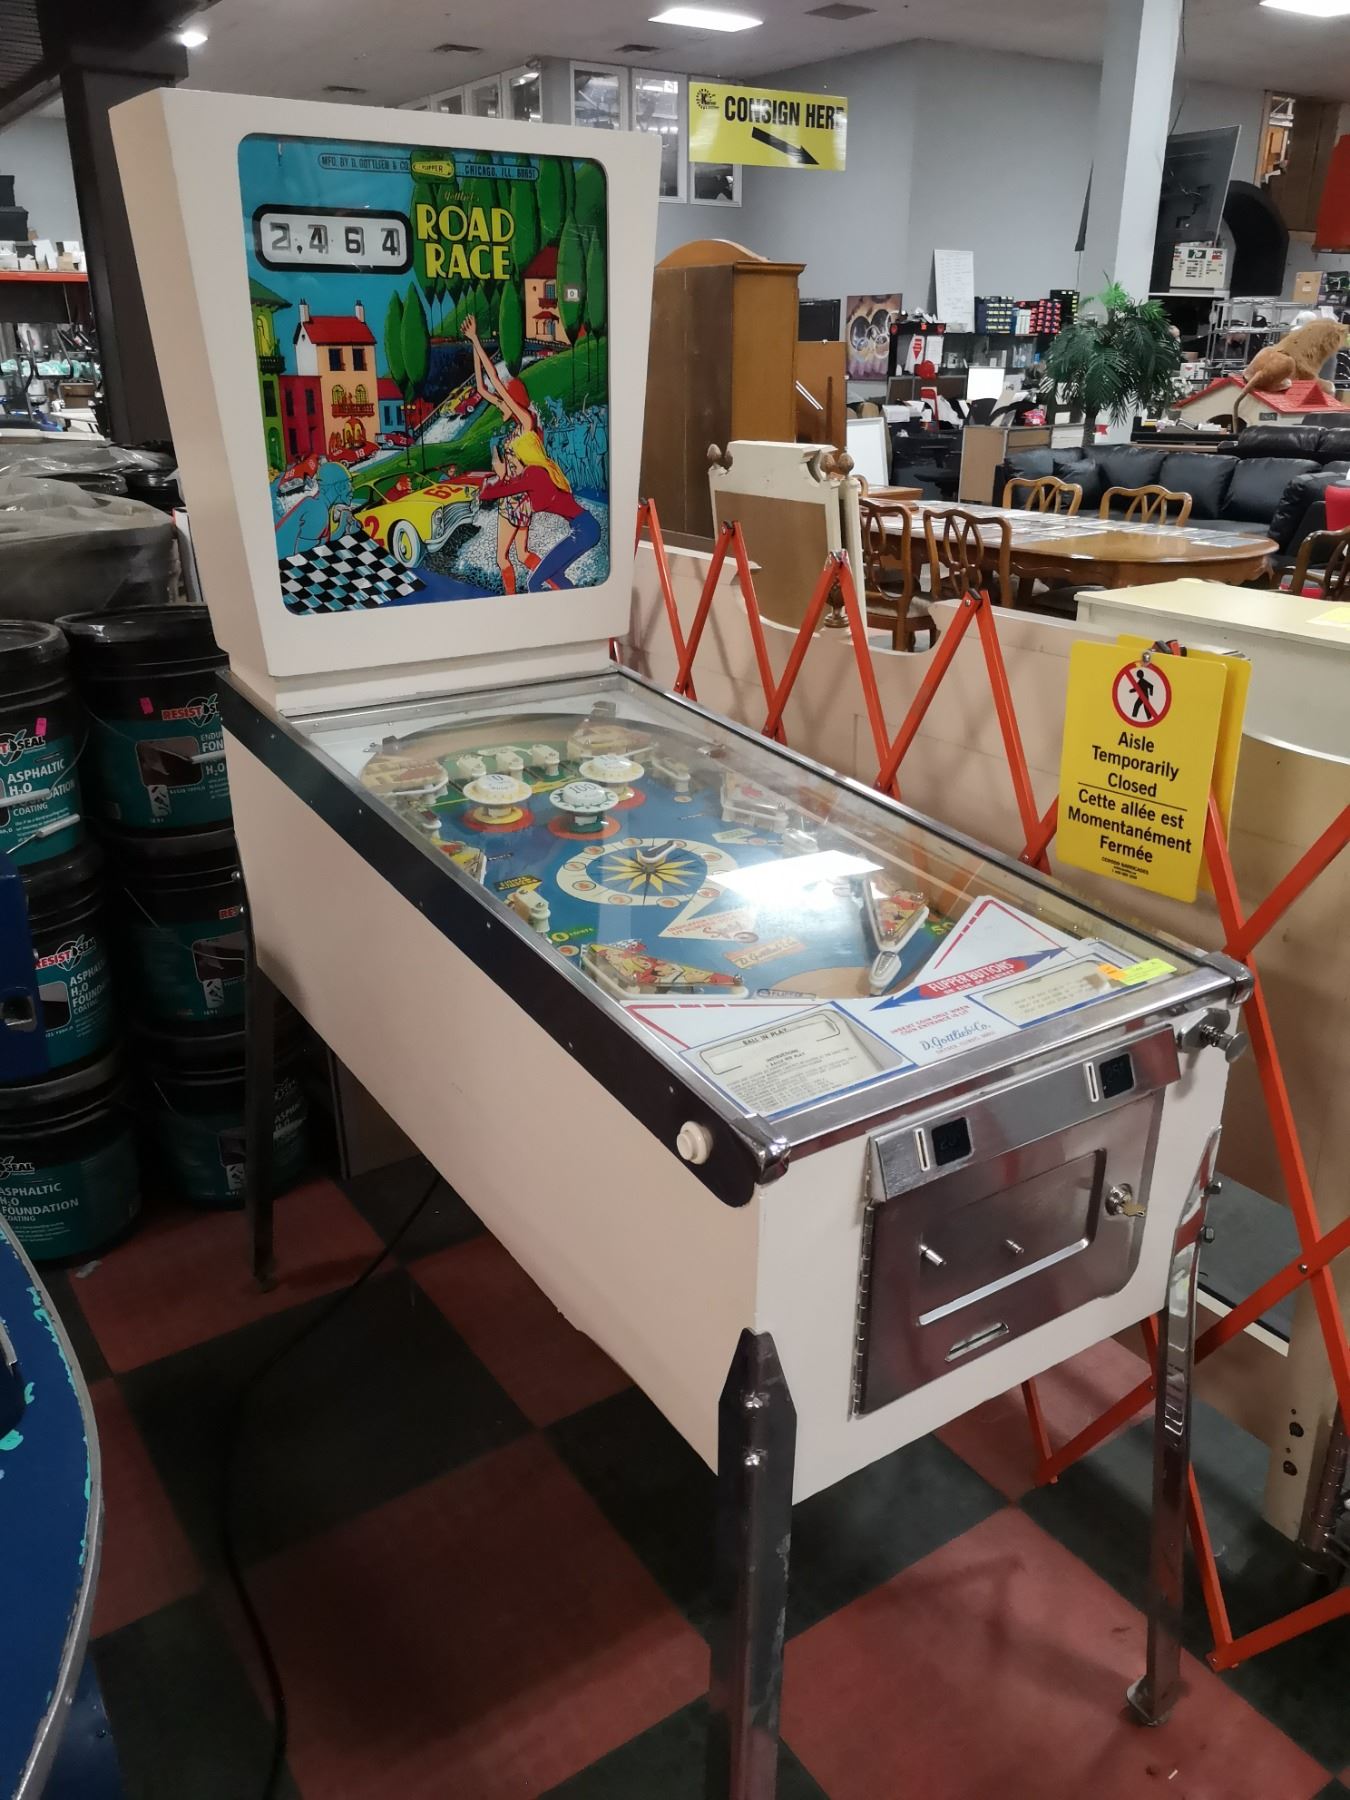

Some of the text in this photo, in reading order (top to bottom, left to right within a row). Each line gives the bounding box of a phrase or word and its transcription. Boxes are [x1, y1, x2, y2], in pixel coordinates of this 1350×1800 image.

[724, 95, 800, 127] CONSIGN
[415, 203, 515, 243] ROAD
[424, 242, 511, 280] RACE
[355, 448, 366, 458] 18
[423, 485, 463, 500] 62
[1117, 731, 1155, 753] Aisle
[7, 758, 65, 784] ASPHALTIC
[1091, 744, 1179, 782] Temporarily
[569, 782, 597, 794] 100
[1107, 772, 1157, 798] Closed
[13, 801, 49, 817] COATING
[1077, 788, 1185, 830] Cette allée est
[1067, 805, 1192, 854] Momentanément
[1099, 834, 1153, 863] Fermée
[927, 960, 1015, 992] FLIPPER BUTTONS
[770, 1027, 788, 1038] PLAY
[0, 1182, 63, 1197] ASPHALTIC
[2, 1197, 79, 1216] FOUNDATION
